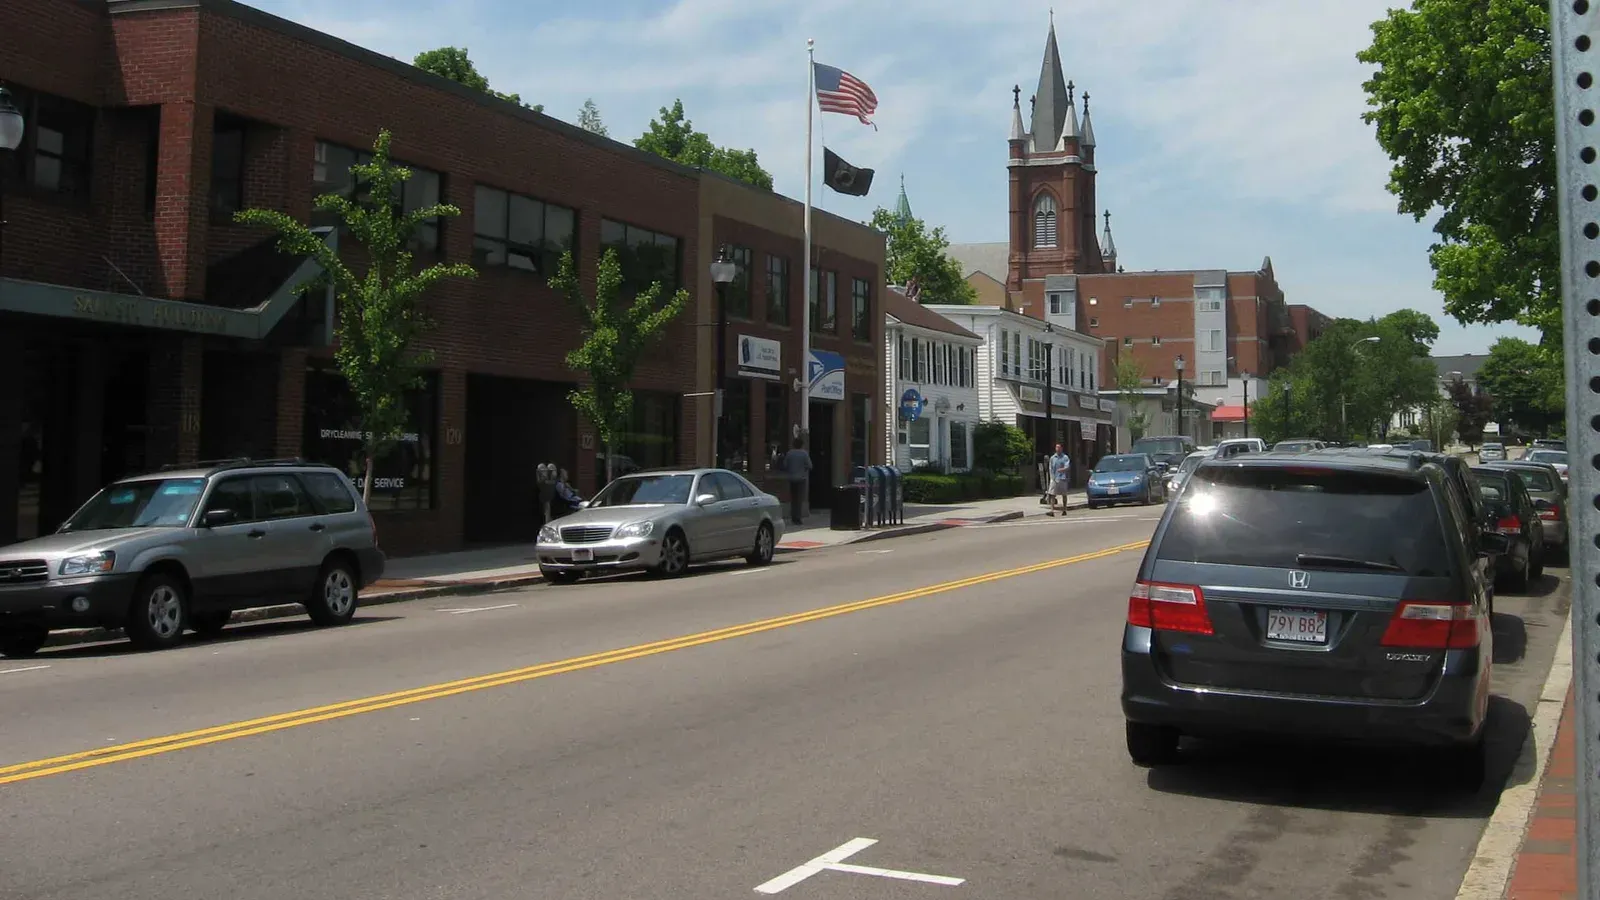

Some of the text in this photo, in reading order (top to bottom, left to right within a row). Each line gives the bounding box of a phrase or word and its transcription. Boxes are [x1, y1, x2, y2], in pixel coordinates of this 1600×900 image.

[320, 428, 362, 440] DRYCLEANING
[374, 477, 404, 488] SERVICE
[1270, 615, 1295, 632] 79Y
